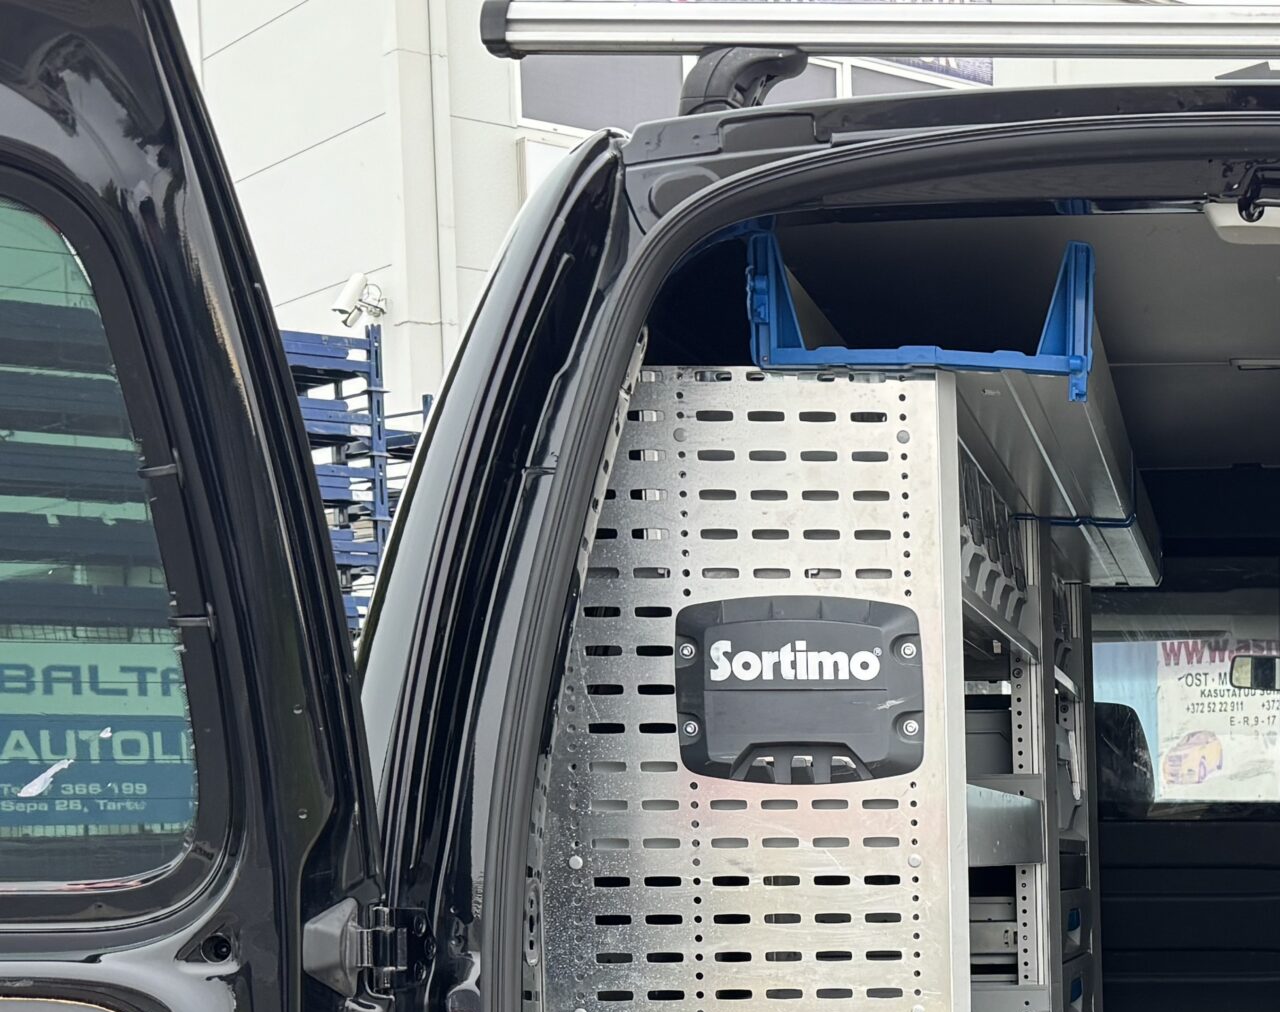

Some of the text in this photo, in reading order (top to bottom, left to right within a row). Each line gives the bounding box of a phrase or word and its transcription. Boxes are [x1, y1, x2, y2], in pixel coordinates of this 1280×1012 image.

[710, 640, 881, 681] Sortimo
[1185, 673, 1209, 687] OST
[1186, 702, 1205, 714] +372
[1207, 702, 1216, 713] 52
[1219, 701, 1228, 712] 22
[1230, 700, 1244, 712] 911
[61, 783, 102, 795] 366
